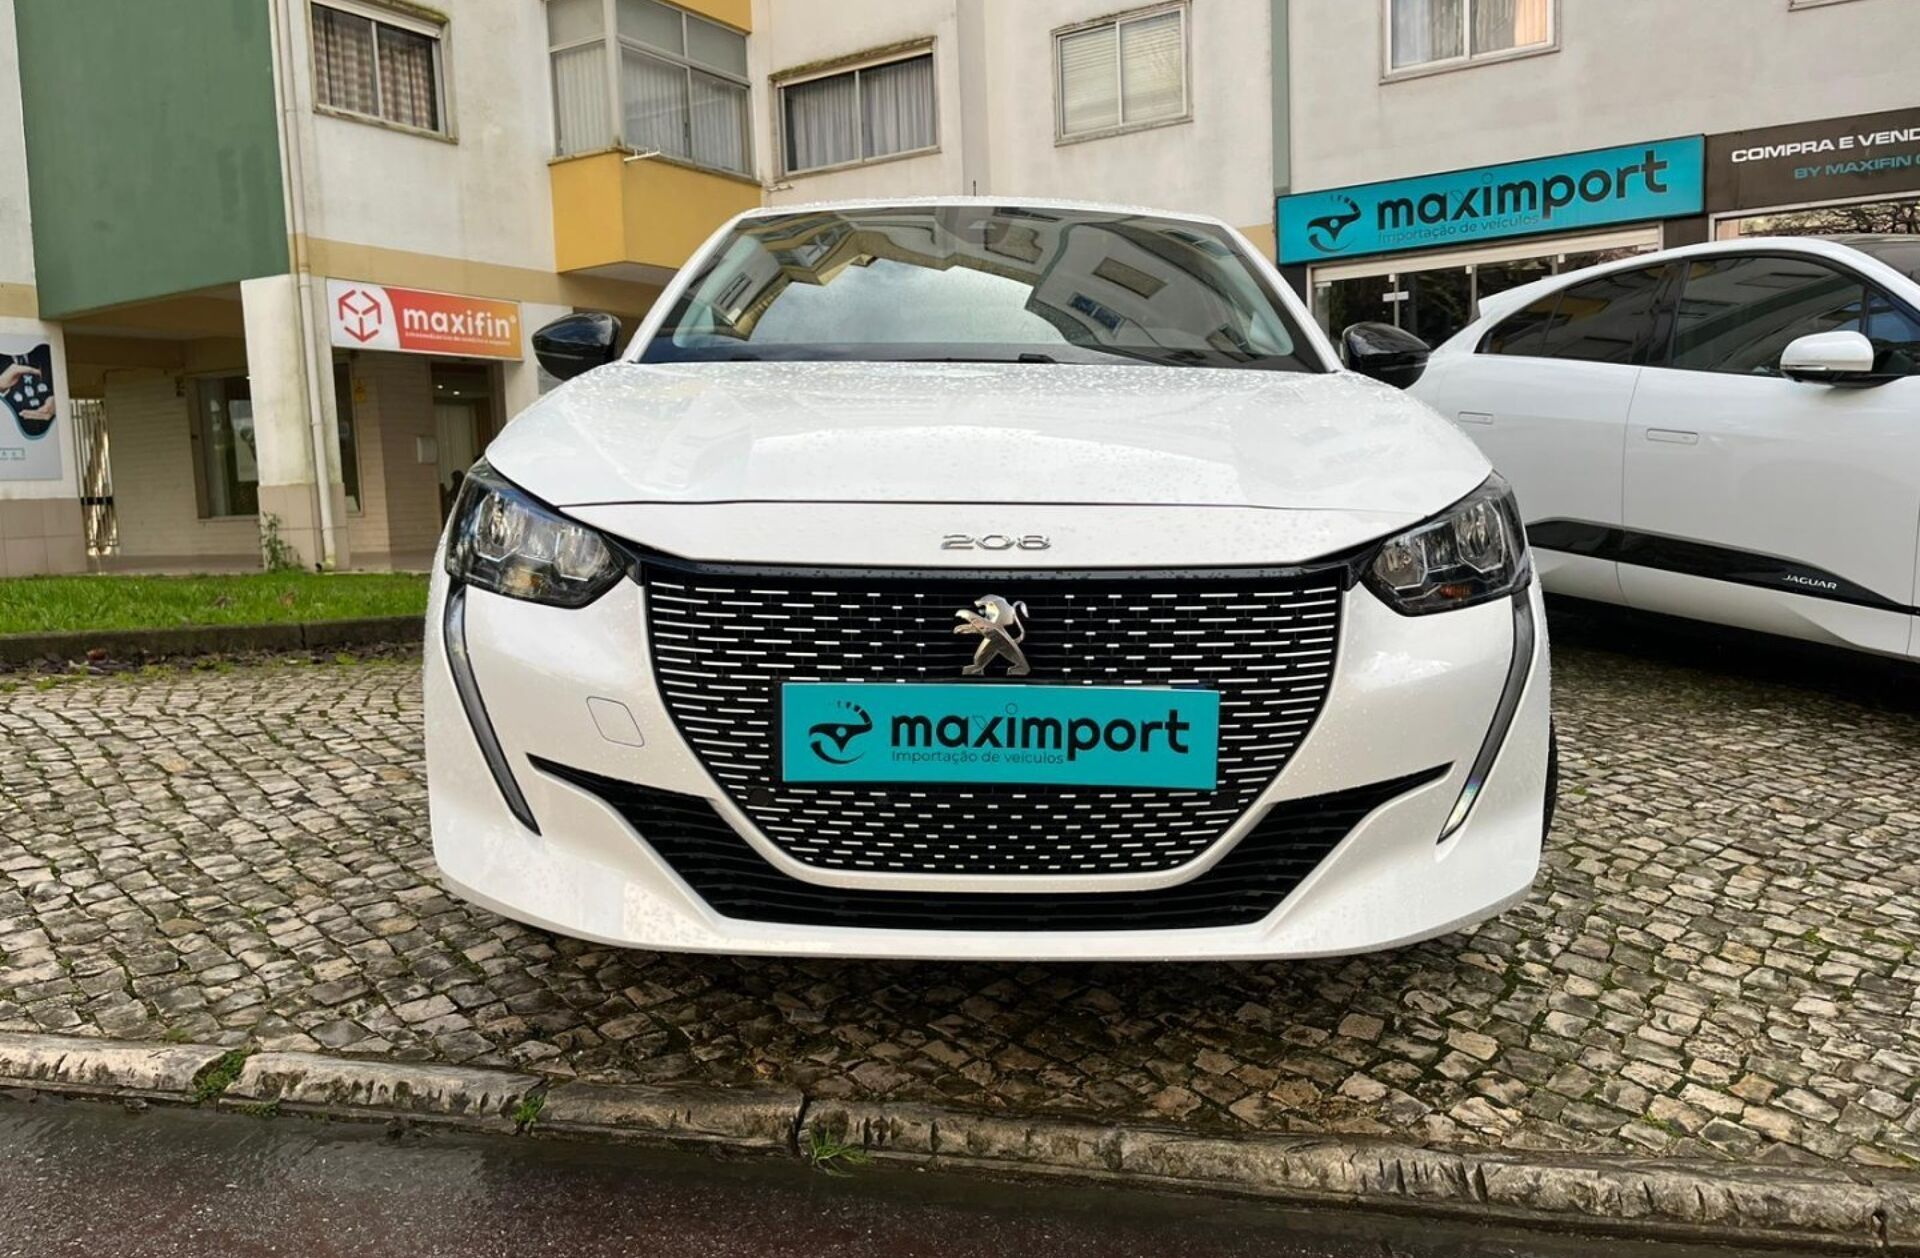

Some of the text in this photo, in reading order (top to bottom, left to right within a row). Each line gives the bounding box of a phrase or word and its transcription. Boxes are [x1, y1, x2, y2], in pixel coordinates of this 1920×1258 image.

[1731, 139, 1835, 163] COMPRA
[1839, 136, 1854, 149] E
[1794, 166, 1821, 180] BY
[1825, 154, 1912, 176] MAXIFIN
[1377, 150, 1667, 230] maximport
[1459, 221, 1478, 233] de
[941, 534, 1051, 550] 208
[1782, 575, 1837, 590] JAGUAR
[891, 702, 1190, 762] maximport
[981, 750, 1000, 763] de
